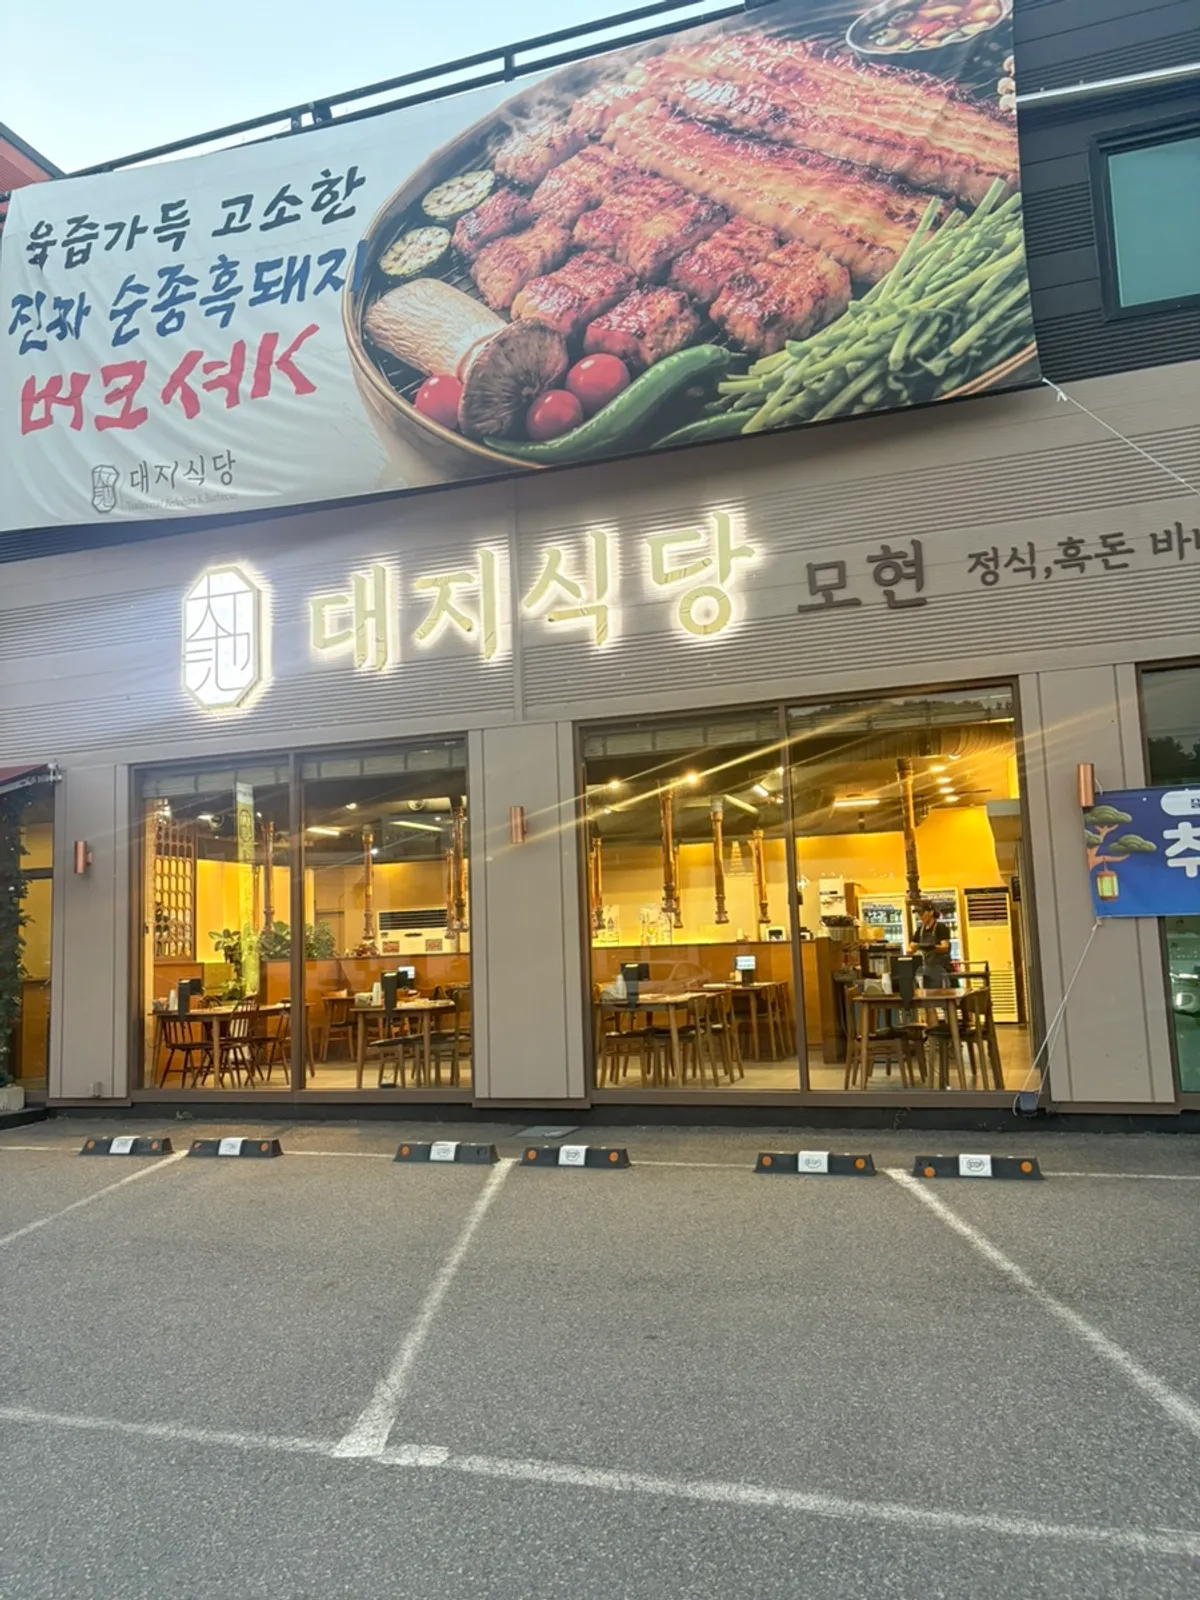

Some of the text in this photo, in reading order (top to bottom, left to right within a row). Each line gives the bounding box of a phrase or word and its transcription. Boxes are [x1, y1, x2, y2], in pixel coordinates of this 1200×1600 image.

[26, 165, 367, 270] 육즙가득 고소한
[8, 290, 91, 356] 진짜
[20, 323, 320, 436] 버크셔K
[130, 450, 236, 494] 대지식당
[310, 509, 759, 673] 대지식당
[798, 539, 928, 613] 모현
